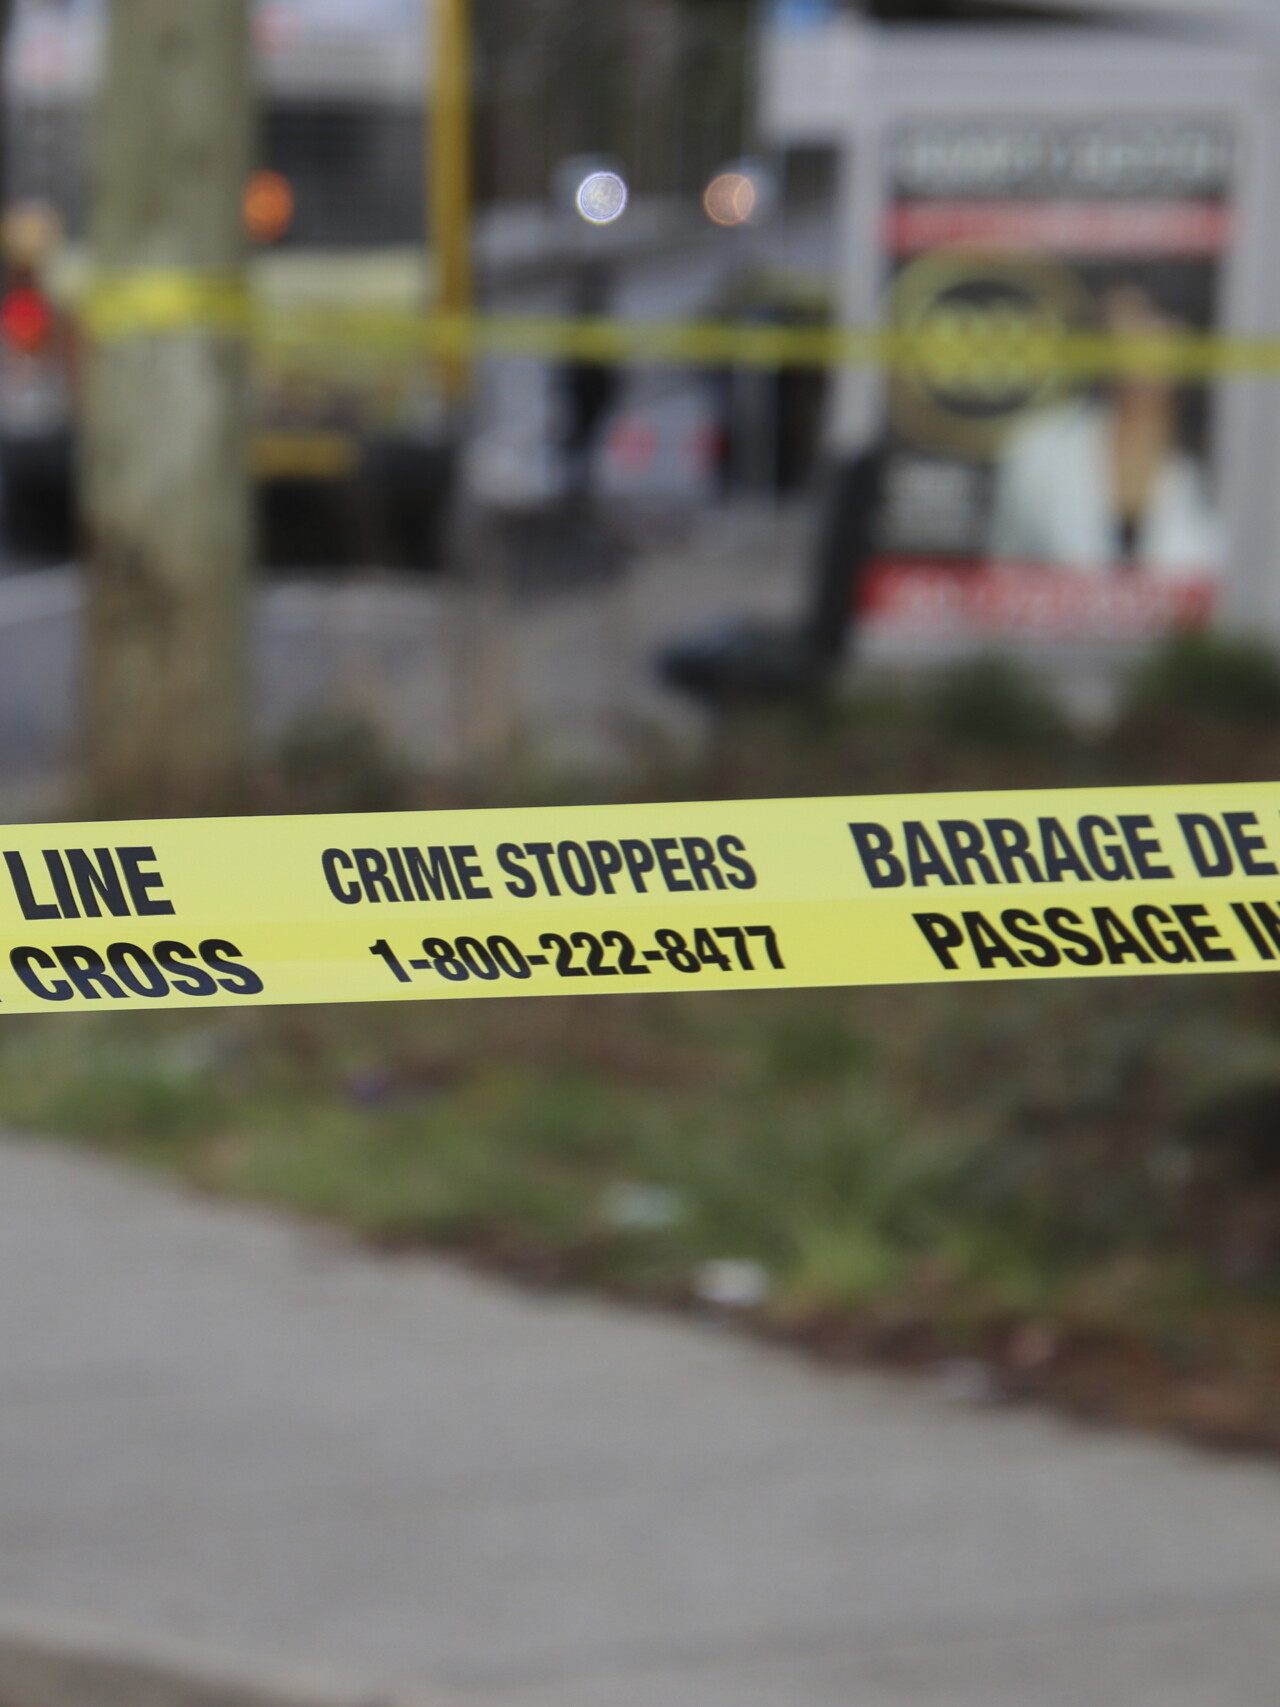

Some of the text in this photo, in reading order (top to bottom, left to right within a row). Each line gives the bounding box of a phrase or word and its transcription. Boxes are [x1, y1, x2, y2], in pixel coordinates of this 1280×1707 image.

[2, 846, 176, 921] LINE
[321, 834, 757, 905] CRIME STOPPERS
[848, 812, 1279, 889] BARRAGE DE
[9, 938, 264, 1002] CROSS
[368, 925, 786, 983] 1-800-222-8477
[911, 903, 1236, 970] PASSAGE
